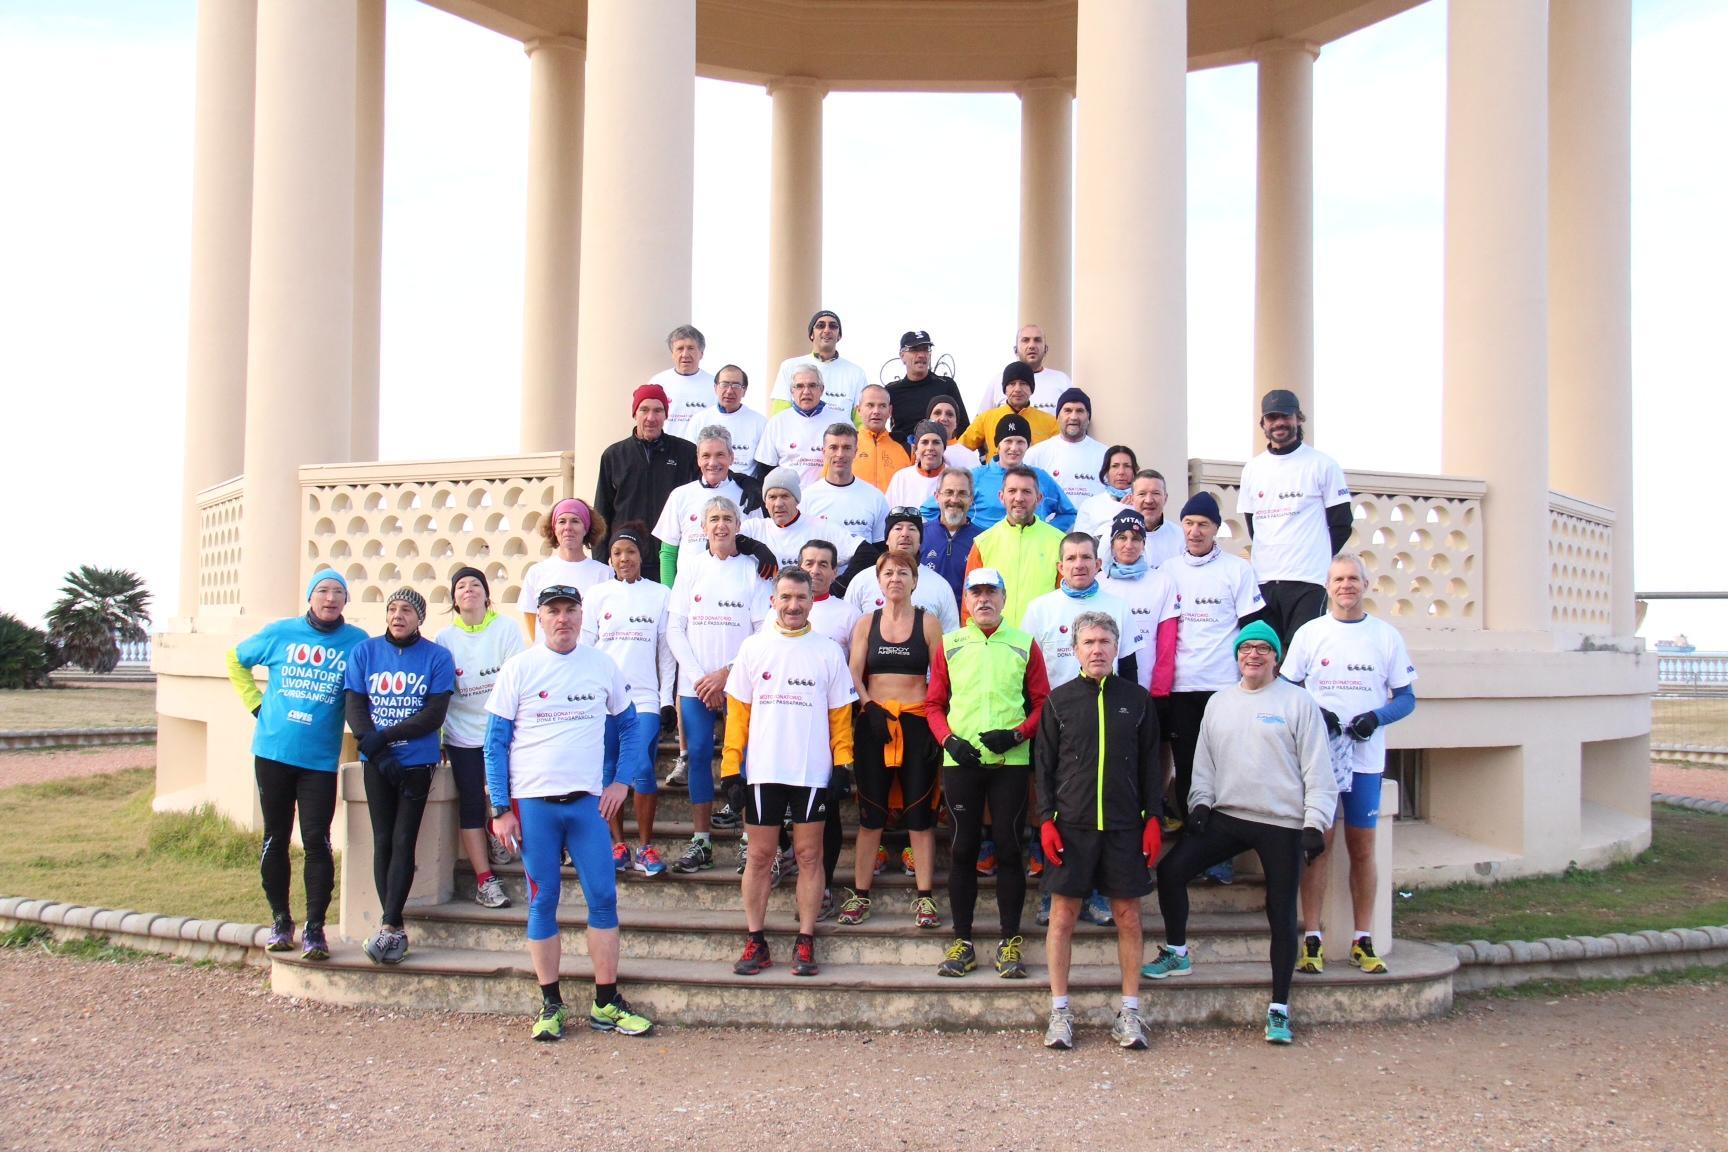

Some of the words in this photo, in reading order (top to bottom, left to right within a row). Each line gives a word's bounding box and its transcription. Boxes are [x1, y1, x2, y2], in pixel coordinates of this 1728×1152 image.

[286, 643, 347, 672] 100%
[281, 665, 343, 684] DONATORE
[369, 671, 428, 696] 100%
[277, 688, 336, 705] PUROSANGUE
[281, 678, 340, 696] LIVORNESE
